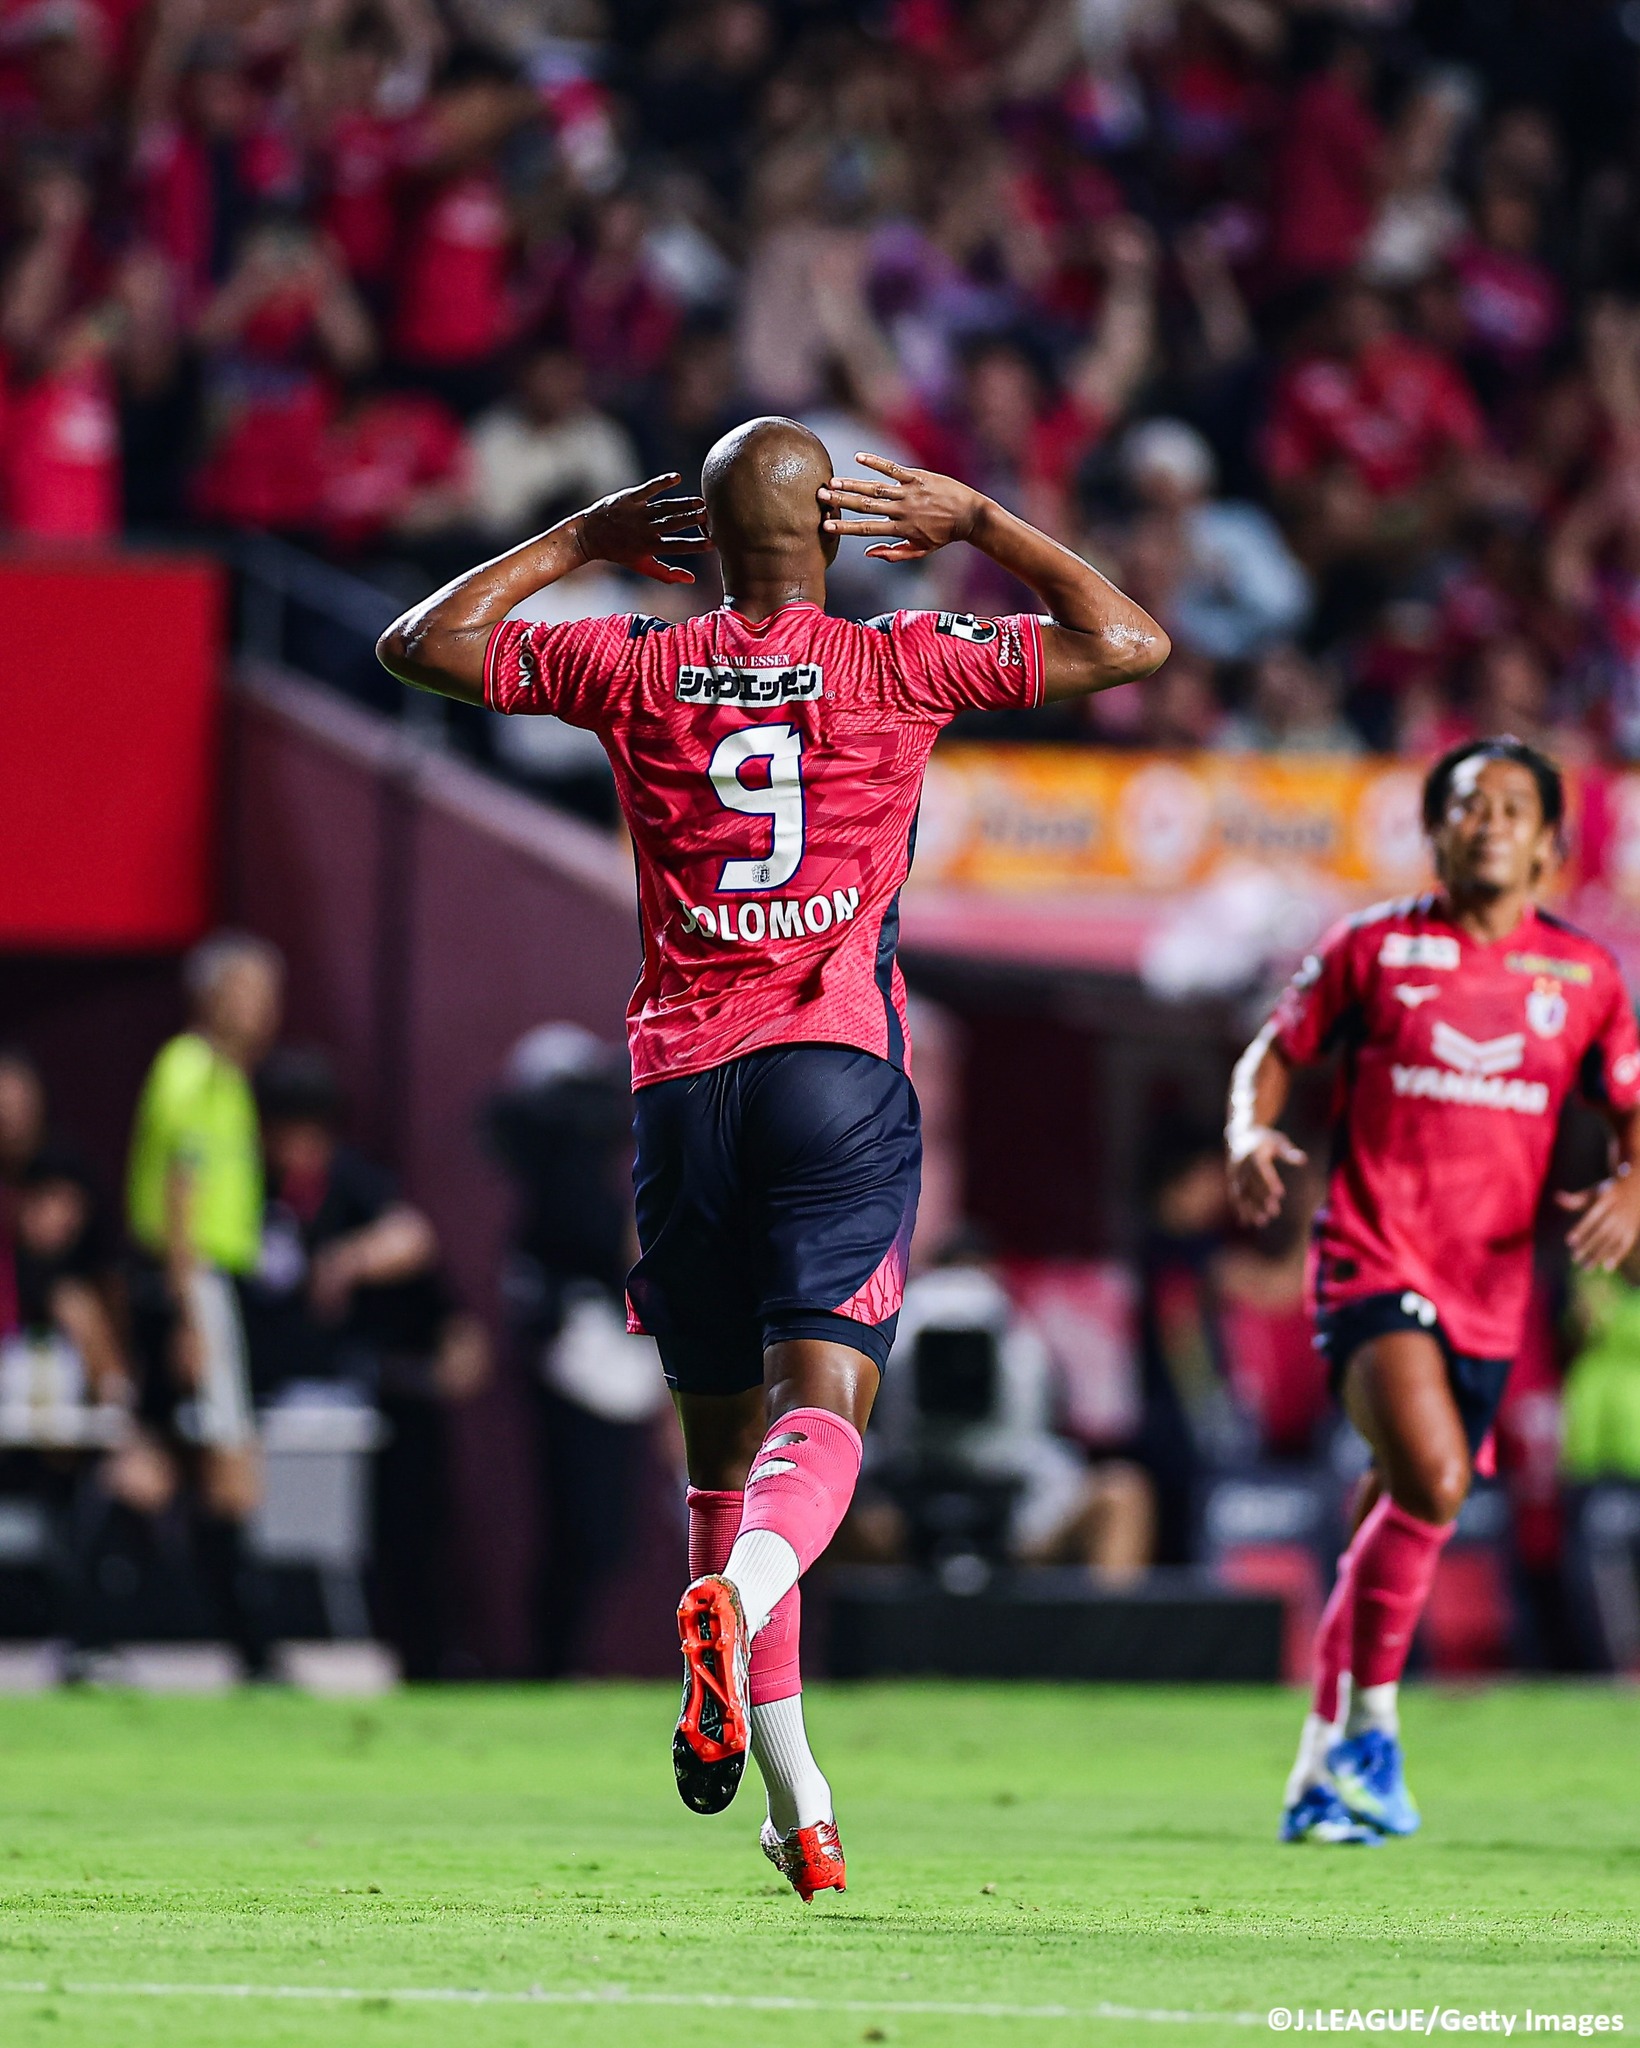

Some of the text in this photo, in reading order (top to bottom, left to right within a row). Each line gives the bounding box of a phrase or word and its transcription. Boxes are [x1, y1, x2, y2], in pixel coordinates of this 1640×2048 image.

[750, 654, 791, 667] ESSEN
[680, 669, 817, 701] シャウエッセン
[707, 722, 805, 892] 9
